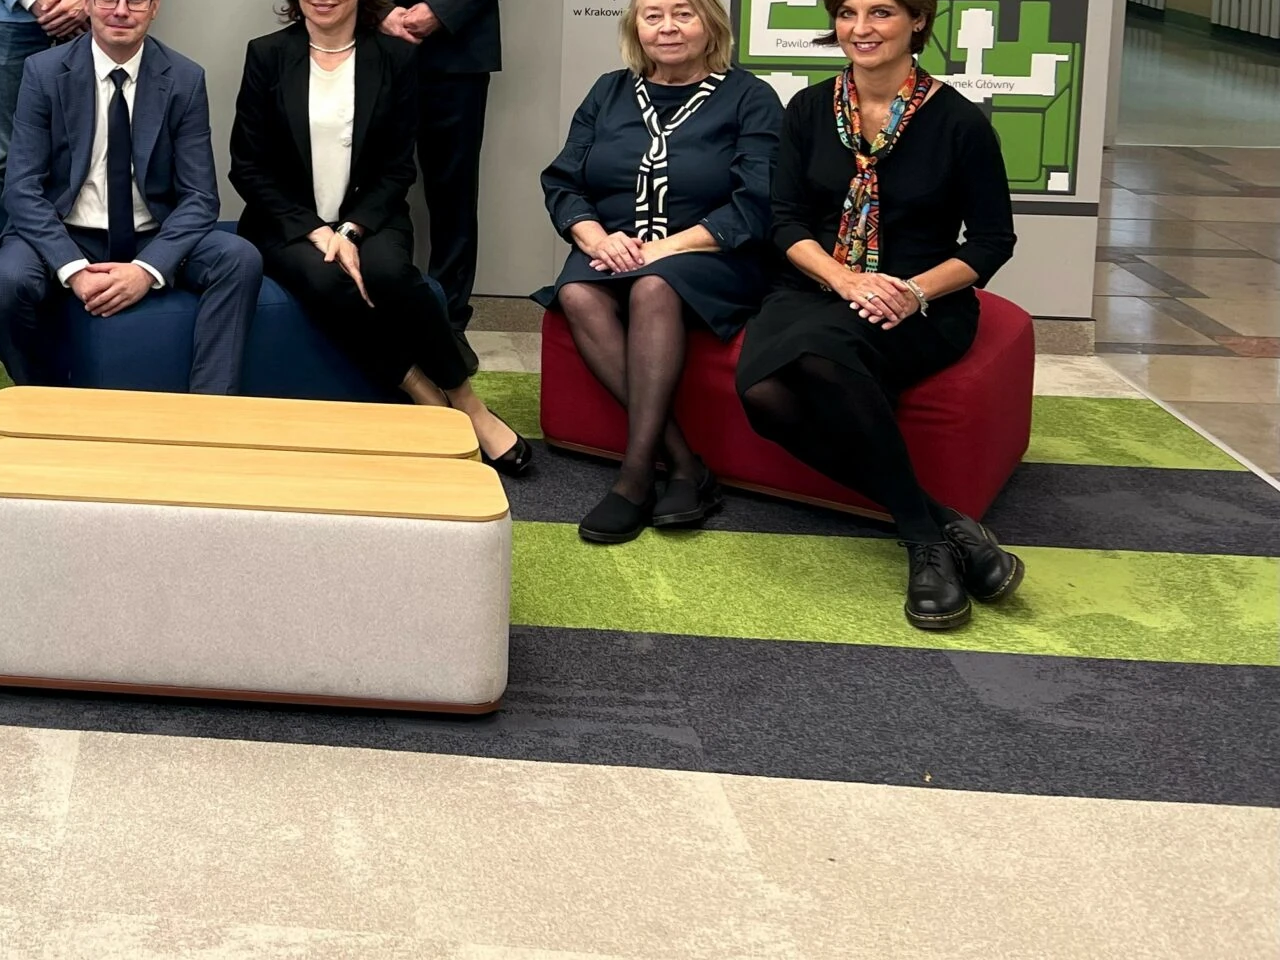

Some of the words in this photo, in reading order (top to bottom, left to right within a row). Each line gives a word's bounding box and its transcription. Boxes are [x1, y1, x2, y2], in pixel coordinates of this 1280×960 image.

[573, 8, 583, 16] w
[584, 7, 623, 17] Krakowi
[975, 78, 1015, 92] Główny
